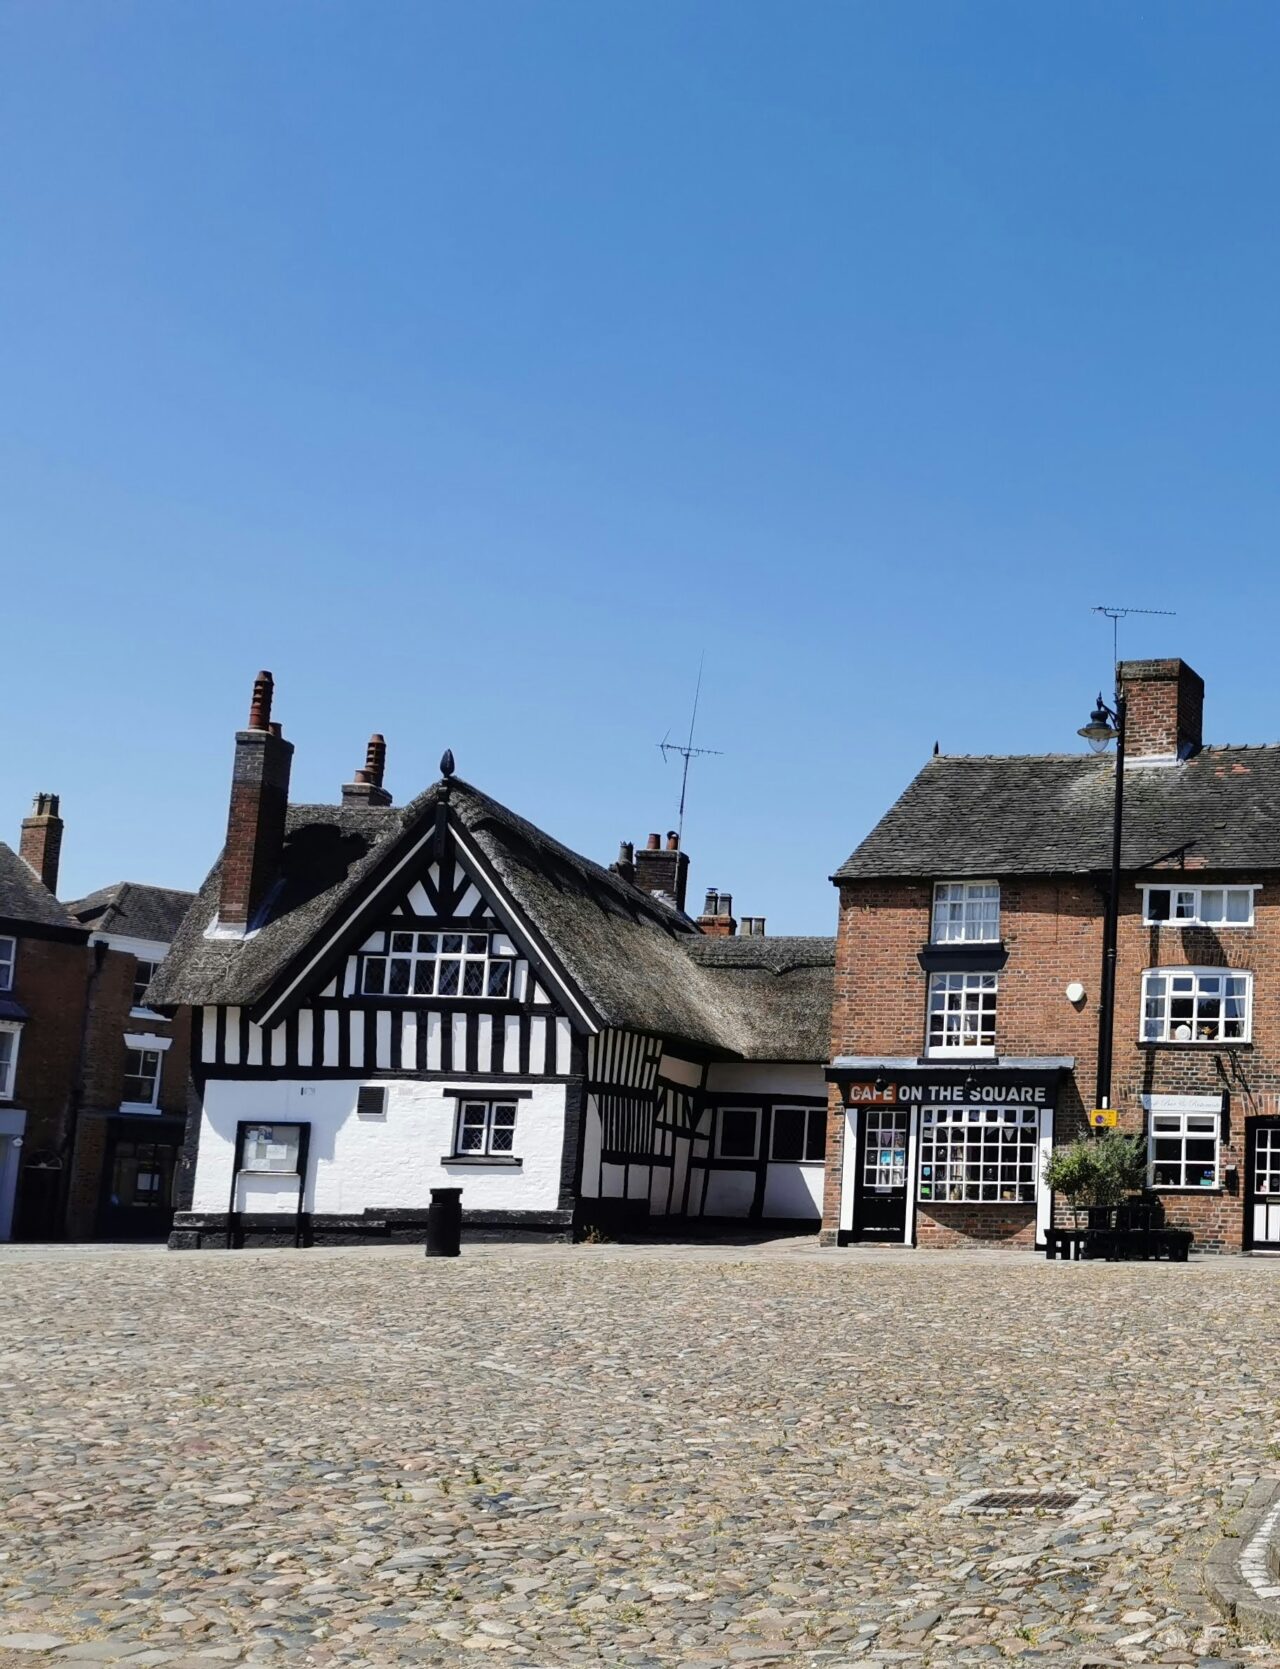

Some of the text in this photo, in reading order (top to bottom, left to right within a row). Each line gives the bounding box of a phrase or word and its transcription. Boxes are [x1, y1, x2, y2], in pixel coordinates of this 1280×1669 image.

[850, 1085, 1046, 1102] CAFE ON THE SQUARE
